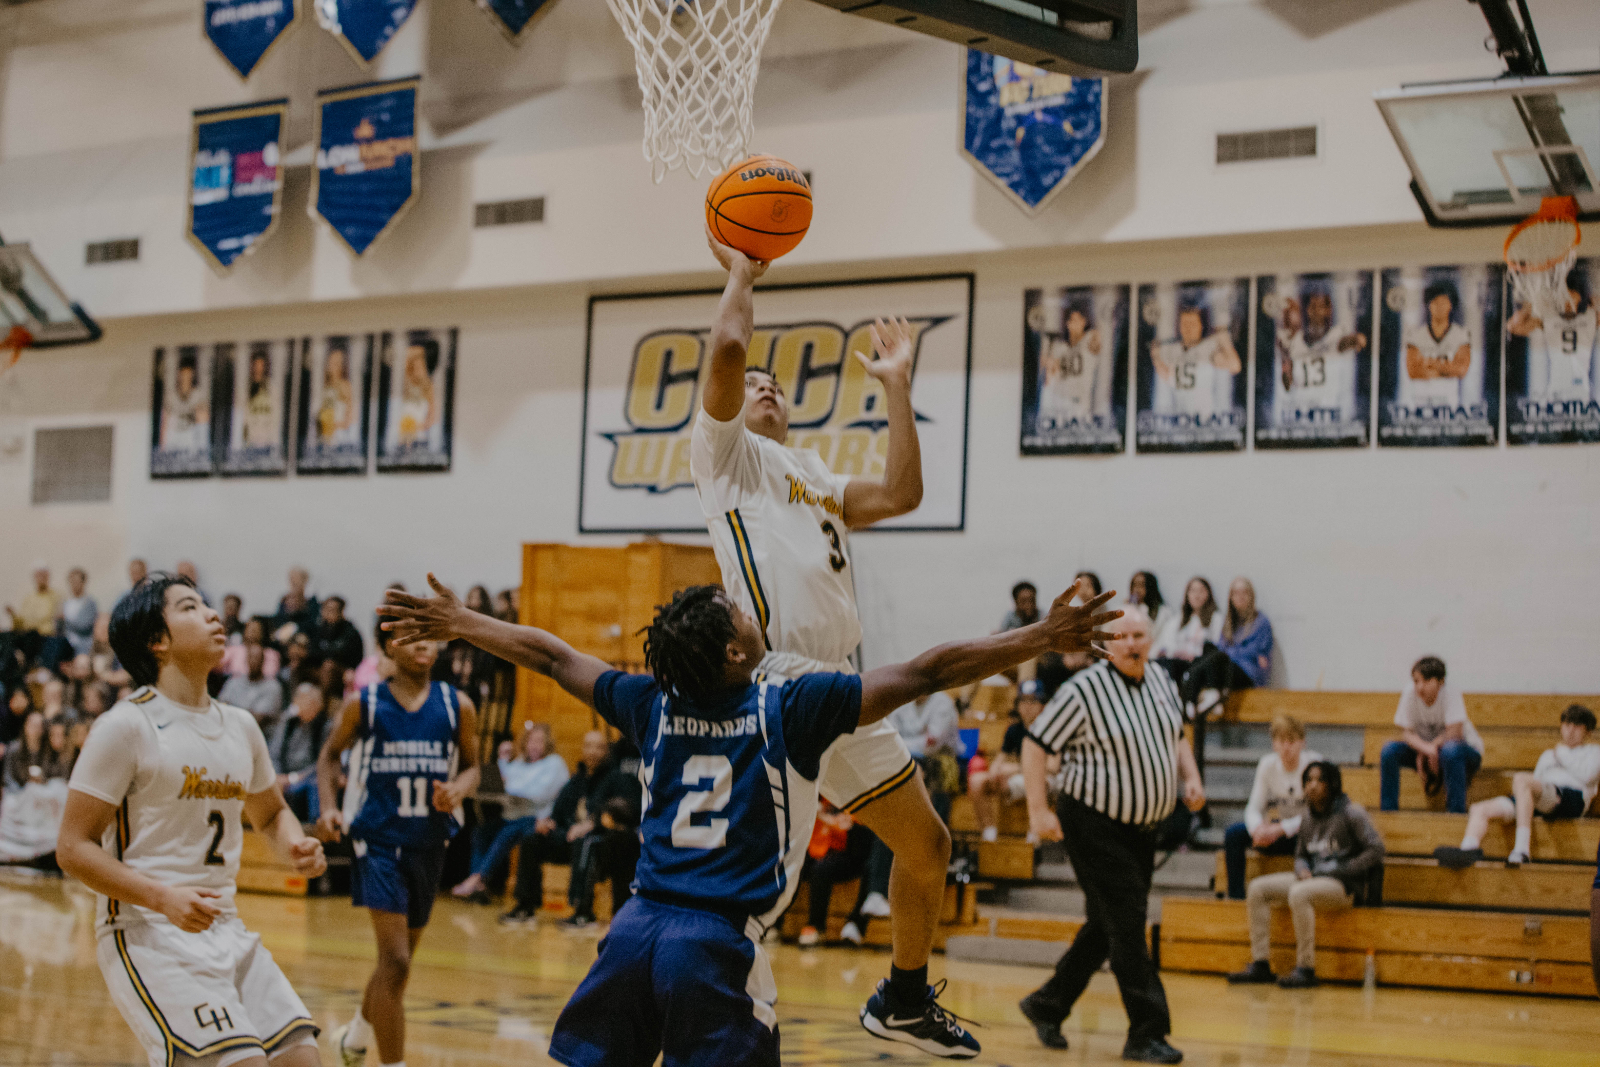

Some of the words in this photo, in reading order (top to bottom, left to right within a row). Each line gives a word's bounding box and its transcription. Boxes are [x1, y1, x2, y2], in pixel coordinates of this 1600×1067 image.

[740, 166, 809, 190] Wilson
[1561, 327, 1579, 354] 9
[1302, 356, 1326, 387] 13
[820, 519, 846, 574] 3
[662, 714, 758, 738] LEOPARDS
[397, 776, 429, 817] 11
[671, 754, 733, 850] 2
[204, 809, 225, 866] 2
